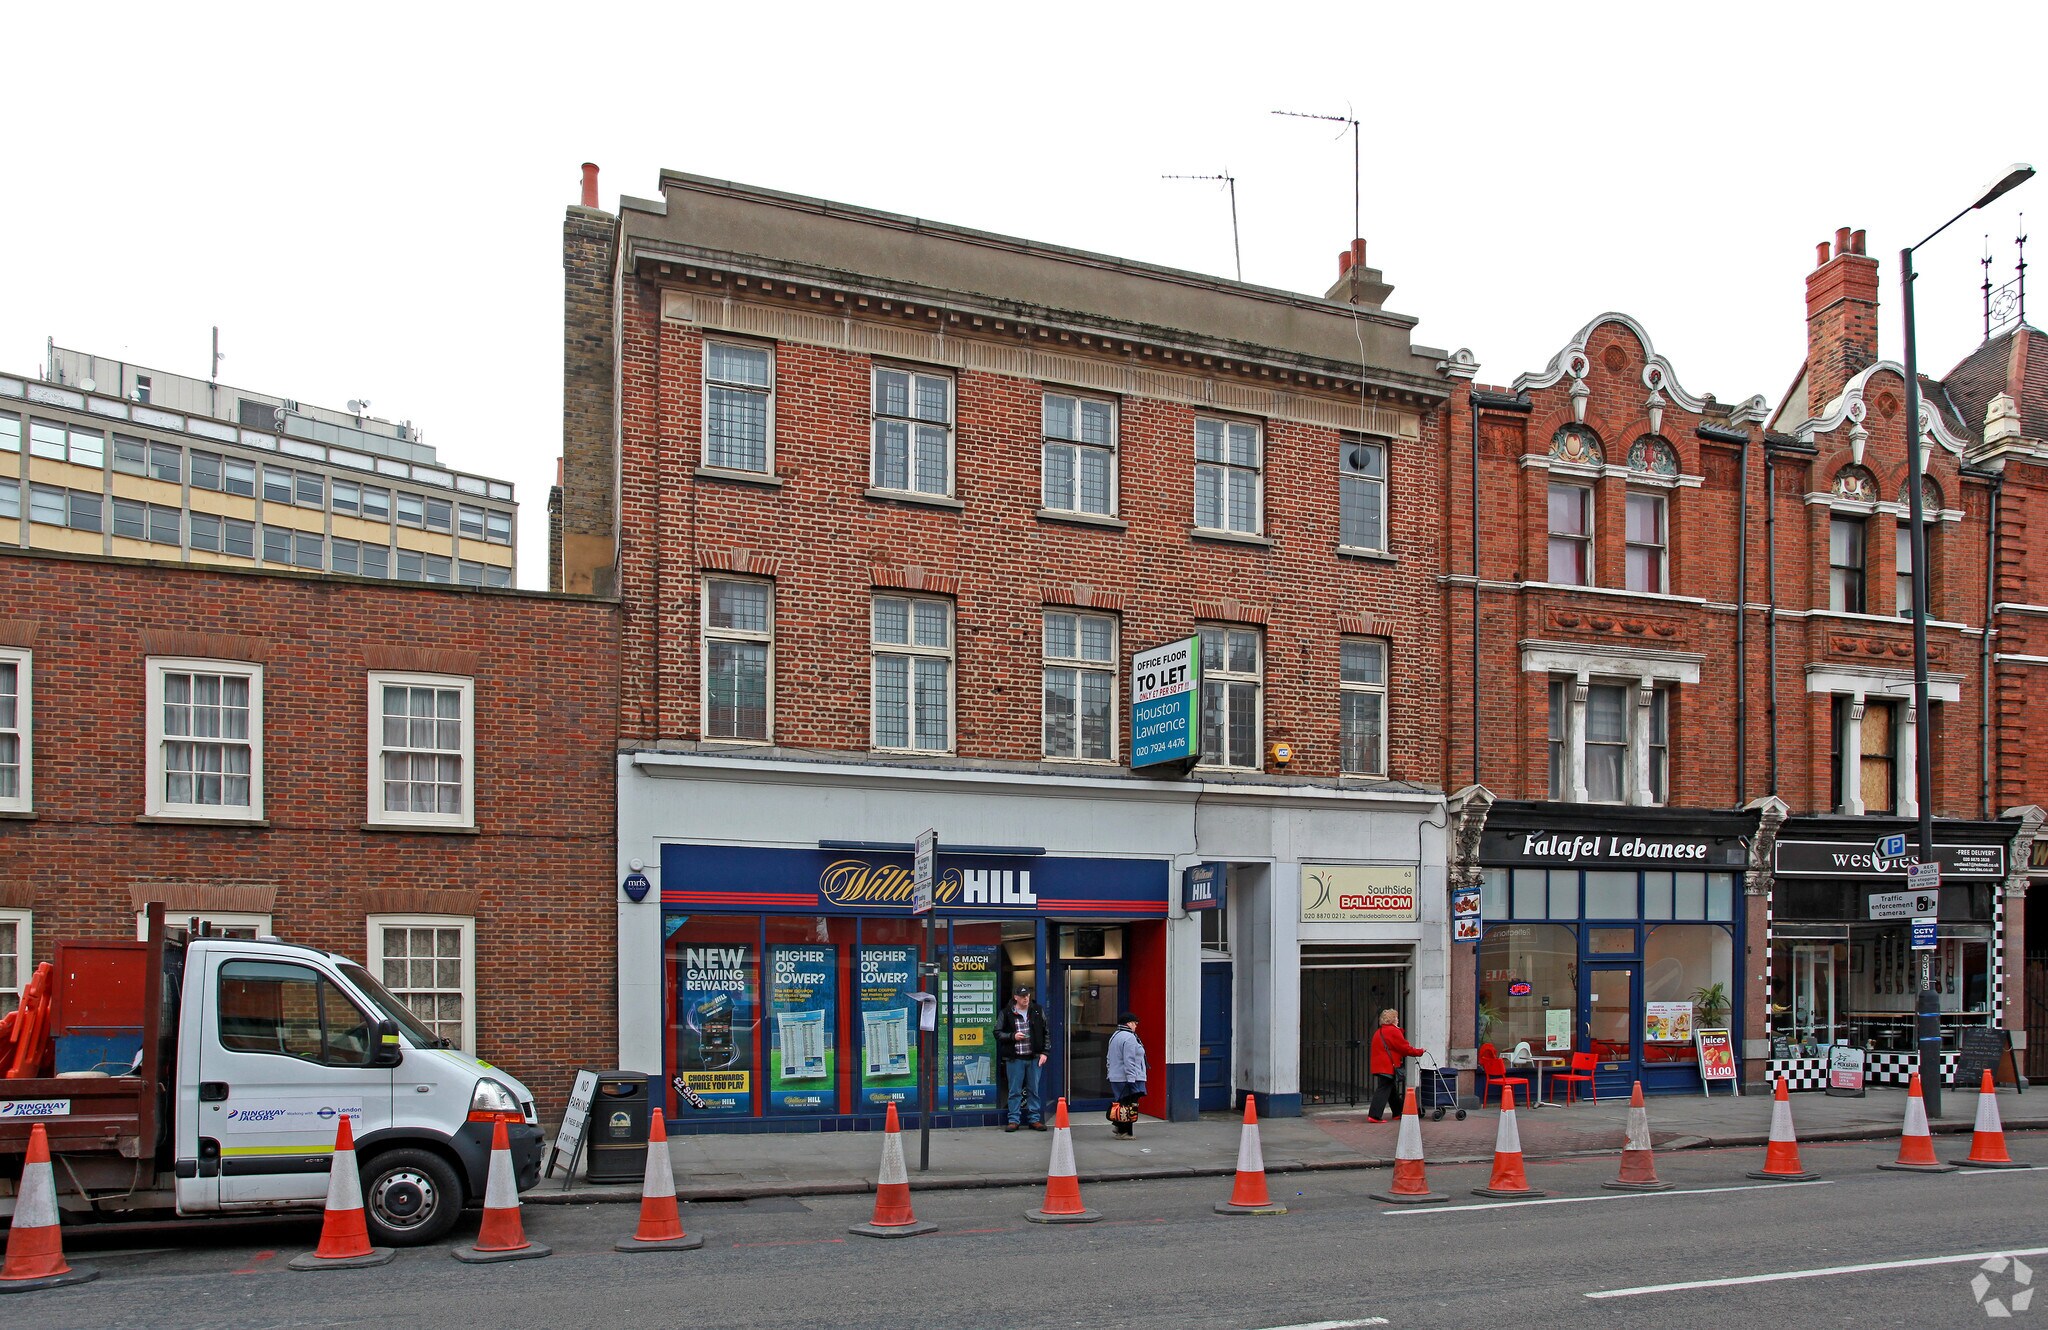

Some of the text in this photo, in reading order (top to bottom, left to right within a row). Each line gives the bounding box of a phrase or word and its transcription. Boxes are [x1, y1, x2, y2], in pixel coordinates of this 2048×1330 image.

[1137, 649, 1187, 671] OFFICE FLOOR
[1137, 664, 1187, 692] TO LET
[1138, 690, 1152, 702] ONLY
[1159, 687, 1169, 697] PER
[1170, 685, 1177, 695] SQ
[1177, 683, 1184, 693] FT
[1136, 701, 1180, 722] Houston
[1136, 717, 1186, 740] Lawrence
[1136, 737, 1186, 757] 020 7924 4476
[1522, 834, 1707, 862] Falafel Lebanese
[1891, 839, 1901, 854] P
[963, 869, 1037, 904] HILL
[1193, 882, 1212, 901] HILL
[1367, 885, 1412, 895] SouthSide
[1341, 897, 1411, 908] BALLROOM
[1871, 901, 1914, 910] enforcement
[686, 948, 745, 969] NEW
[775, 950, 825, 962] HIGHER
[860, 950, 907, 962] HIGHER
[775, 961, 796, 973] OR
[860, 961, 879, 973] OR
[687, 969, 744, 981] GAMING
[775, 972, 826, 984] LOWER?
[860, 972, 909, 984] LOWER?
[686, 980, 745, 991] REWARDS
[1511, 985, 1530, 993] OPEN
[959, 1033, 977, 1041] £120
[1707, 1066, 1732, 1076] £1.00
[688, 1073, 745, 1082] CHOOSE REWARDS
[581, 1080, 590, 1092] NO
[688, 1081, 745, 1090] WHILE YOU PLAY
[673, 1076, 706, 1109] £2 SLOTS
[14, 1108, 53, 1116] JACOBS
[16, 1102, 67, 1110] RINGWAY
[238, 1114, 275, 1122] JACOBS
